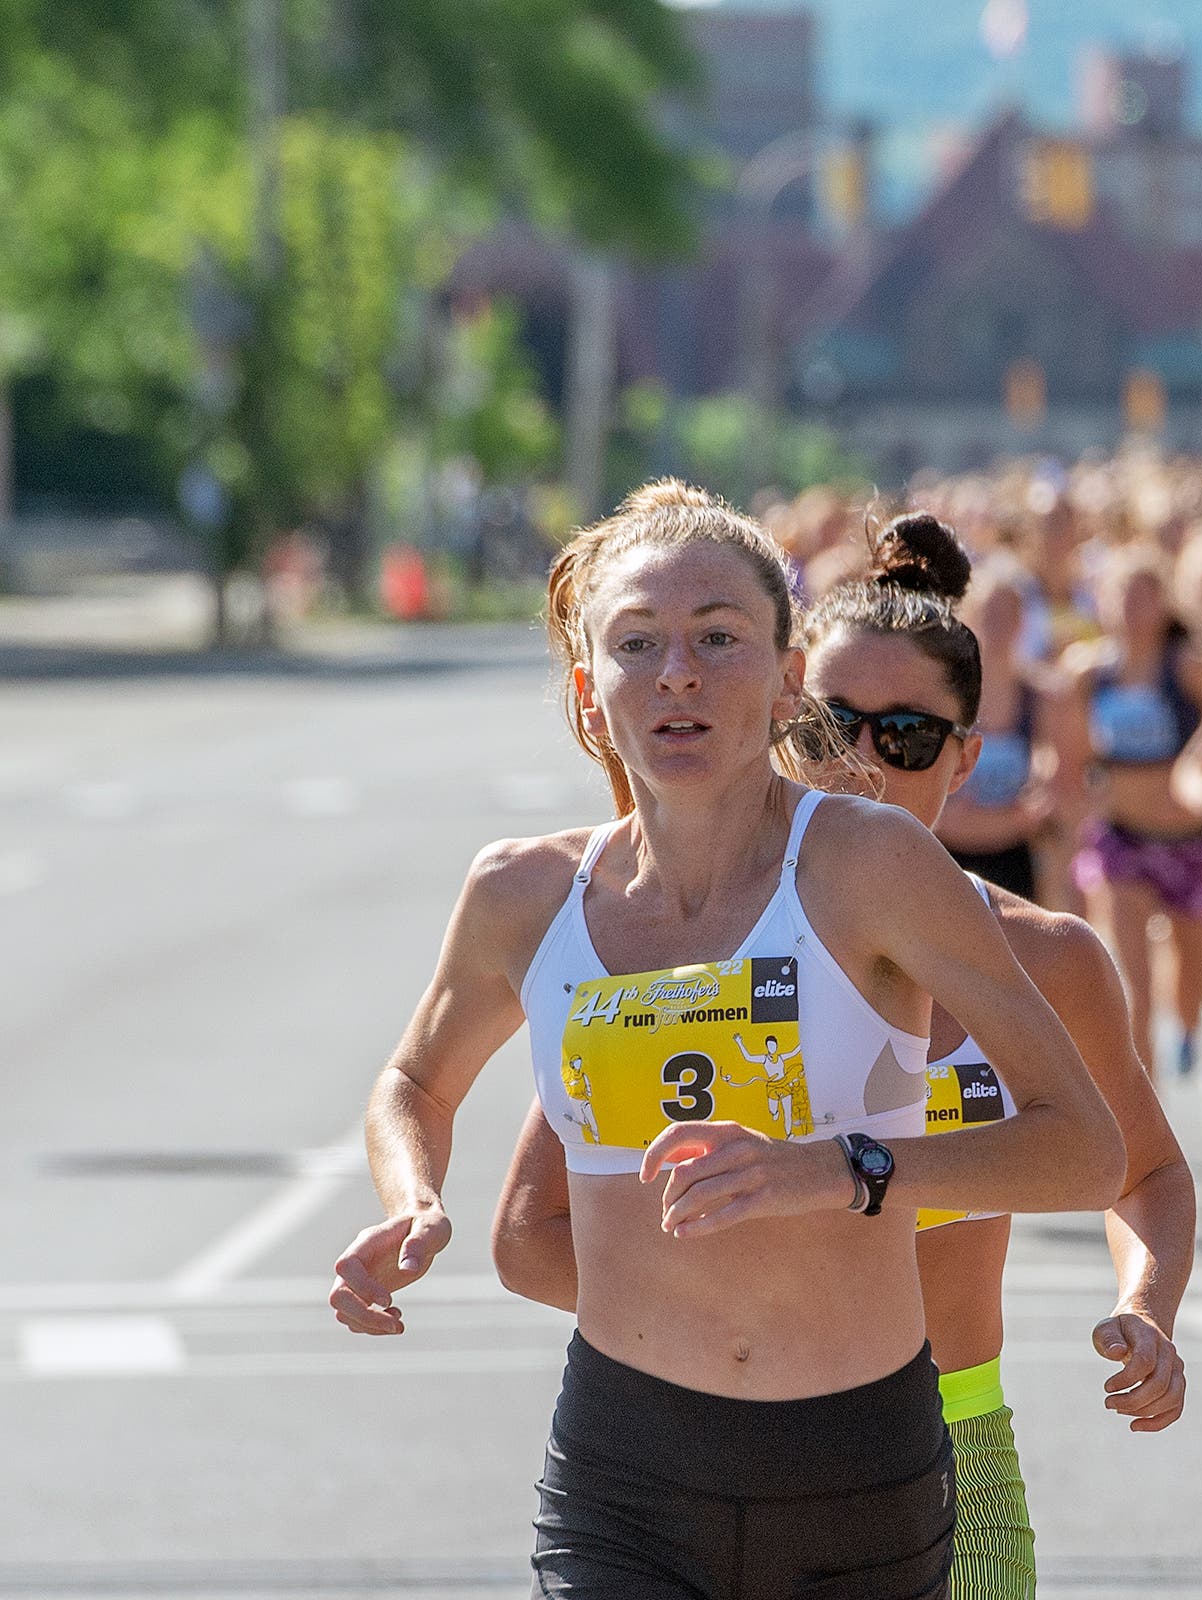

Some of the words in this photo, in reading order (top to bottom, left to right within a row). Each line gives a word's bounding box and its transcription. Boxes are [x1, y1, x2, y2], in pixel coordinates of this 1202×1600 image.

[754, 980, 796, 998] elite
[661, 1051, 716, 1122] 3
[963, 1082, 998, 1099] elite
[926, 1108, 959, 1121] men
